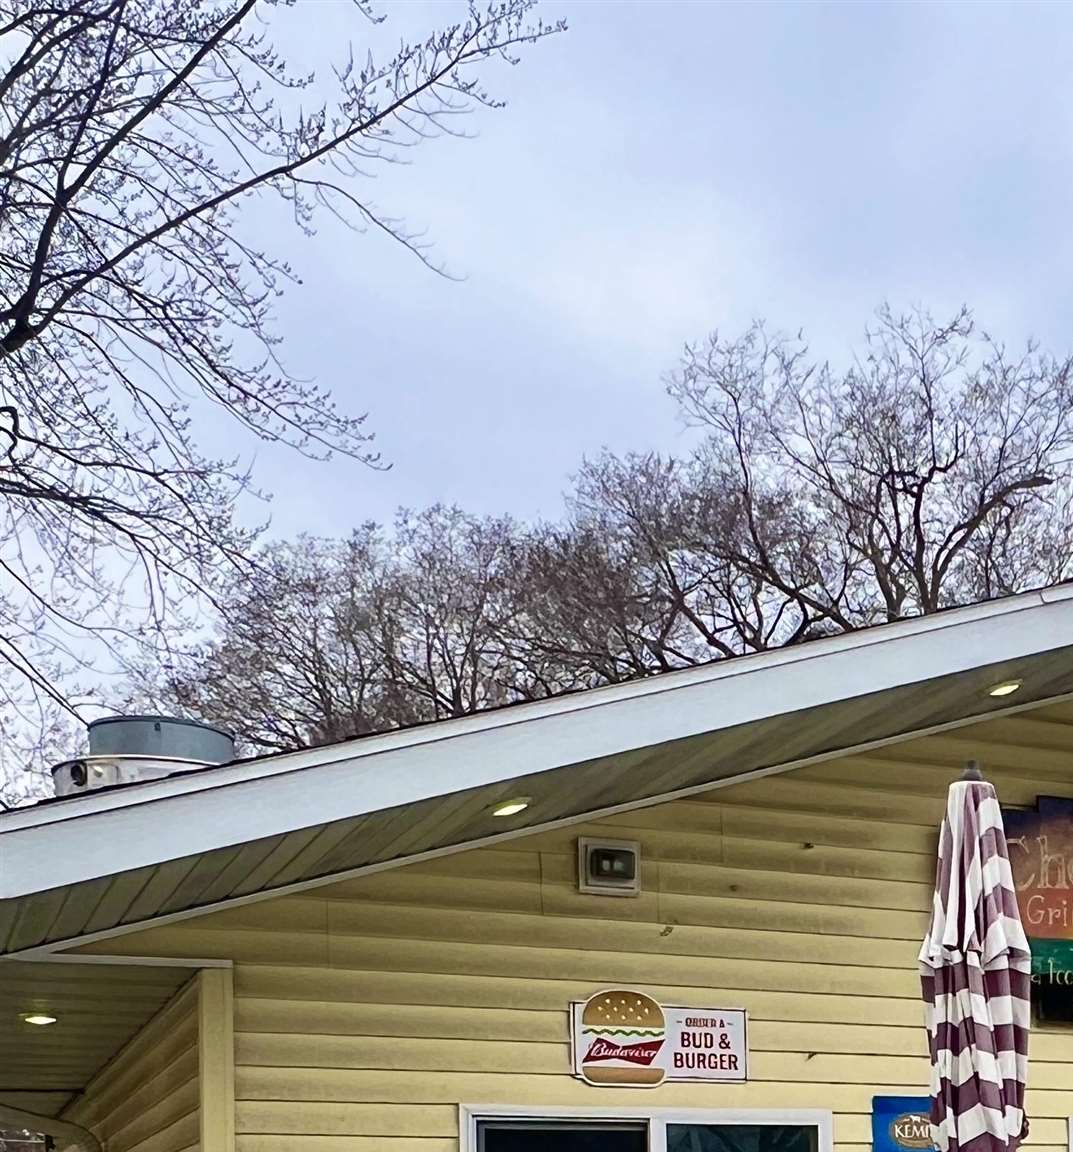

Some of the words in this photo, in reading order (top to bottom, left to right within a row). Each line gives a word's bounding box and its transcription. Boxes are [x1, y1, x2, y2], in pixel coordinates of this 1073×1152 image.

[685, 1017, 717, 1028] ORDER
[719, 1019, 726, 1028] A
[680, 1032, 714, 1049] BUD
[718, 1033, 732, 1050] &
[673, 1052, 739, 1071] BURGER
[894, 1124, 930, 1139] KEM
